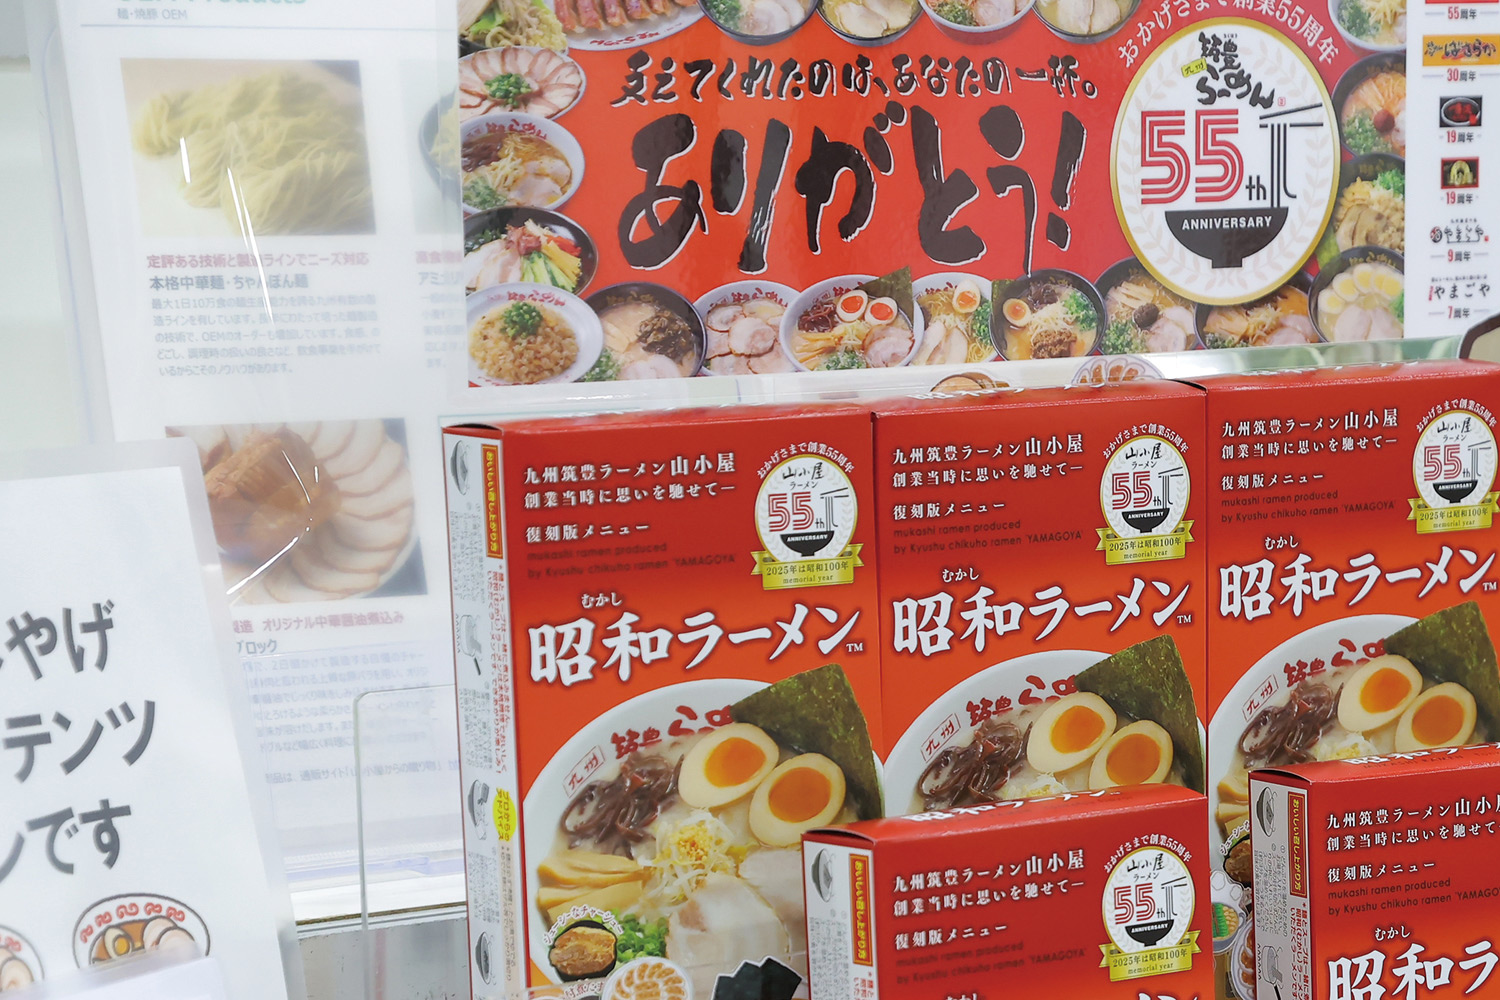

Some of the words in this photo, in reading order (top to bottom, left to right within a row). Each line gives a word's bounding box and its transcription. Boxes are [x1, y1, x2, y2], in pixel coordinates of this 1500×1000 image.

[162, 9, 188, 20] OEM
[1448, 6, 1477, 20] 55周年
[1118, 0, 1340, 68] おかげさ創業55周年
[610, 49, 1098, 106] 支えてくれたのは、あなたの一杯。
[1447, 68, 1476, 82] 30周年
[1446, 130, 1474, 144] 19周年
[617, 100, 1087, 278] ありがとう!
[1446, 192, 1474, 205] 19周年
[1182, 215, 1273, 231] ANNIVERSARY
[1448, 249, 1471, 262] 9周年
[1448, 306, 1470, 319] 7周年
[1222, 408, 1398, 438] 九州筑豊ラーメン山小屋
[1442, 433, 1467, 442] ラーメン
[892, 433, 1083, 465] 九州筑豊ラーメン山小屋
[523, 452, 736, 486] 九州筑豊ラーメン山小屋
[1132, 460, 1157, 469] ラーメン
[1221, 473, 1325, 490] 復刻版メニュー
[1438, 482, 1472, 490] ANNIVERSARY
[893, 502, 1005, 520] 復刻版メニュー
[1128, 511, 1164, 519] ANNIVERSARY
[1419, 507, 1488, 521] 2025年は昭和100年
[526, 522, 650, 543] 復刻版メニュー
[786, 534, 828, 543] ANNIVERSARY
[1109, 537, 1182, 551] 2025年は昭和100年
[1265, 535, 1299, 550] むかし
[766, 560, 850, 576] 2025年は昭和100年
[942, 567, 979, 582] むかし
[1220, 546, 1496, 620] 昭和ラーメン
[581, 592, 622, 609] むかし
[892, 577, 1190, 657] 昭和ラーメン
[0, 599, 115, 681] やげ
[528, 603, 860, 687] 昭和ラーメン
[2, 700, 156, 783] テンツ
[566, 753, 601, 790] 九州
[1293, 799, 1302, 891] おいしい召し上がり方
[893, 849, 1085, 893] 九州筑豊ラーメン山小屋
[1328, 861, 1436, 883] 復刻版メニュー
[1329, 886, 1367, 898] mukashi
[1371, 884, 1401, 895] ramen
[1404, 878, 1450, 893] produced
[1329, 906, 1340, 917] by
[1344, 901, 1377, 916] Kyushu
[1380, 897, 1418, 911] chikuho
[1422, 895, 1452, 905] ramen
[895, 923, 1007, 950] 復刻版メニュー
[1132, 923, 1168, 933] ANNIVERSARY
[1375, 926, 1411, 941] むかし
[1113, 949, 1187, 969] 2025年は昭和100年
